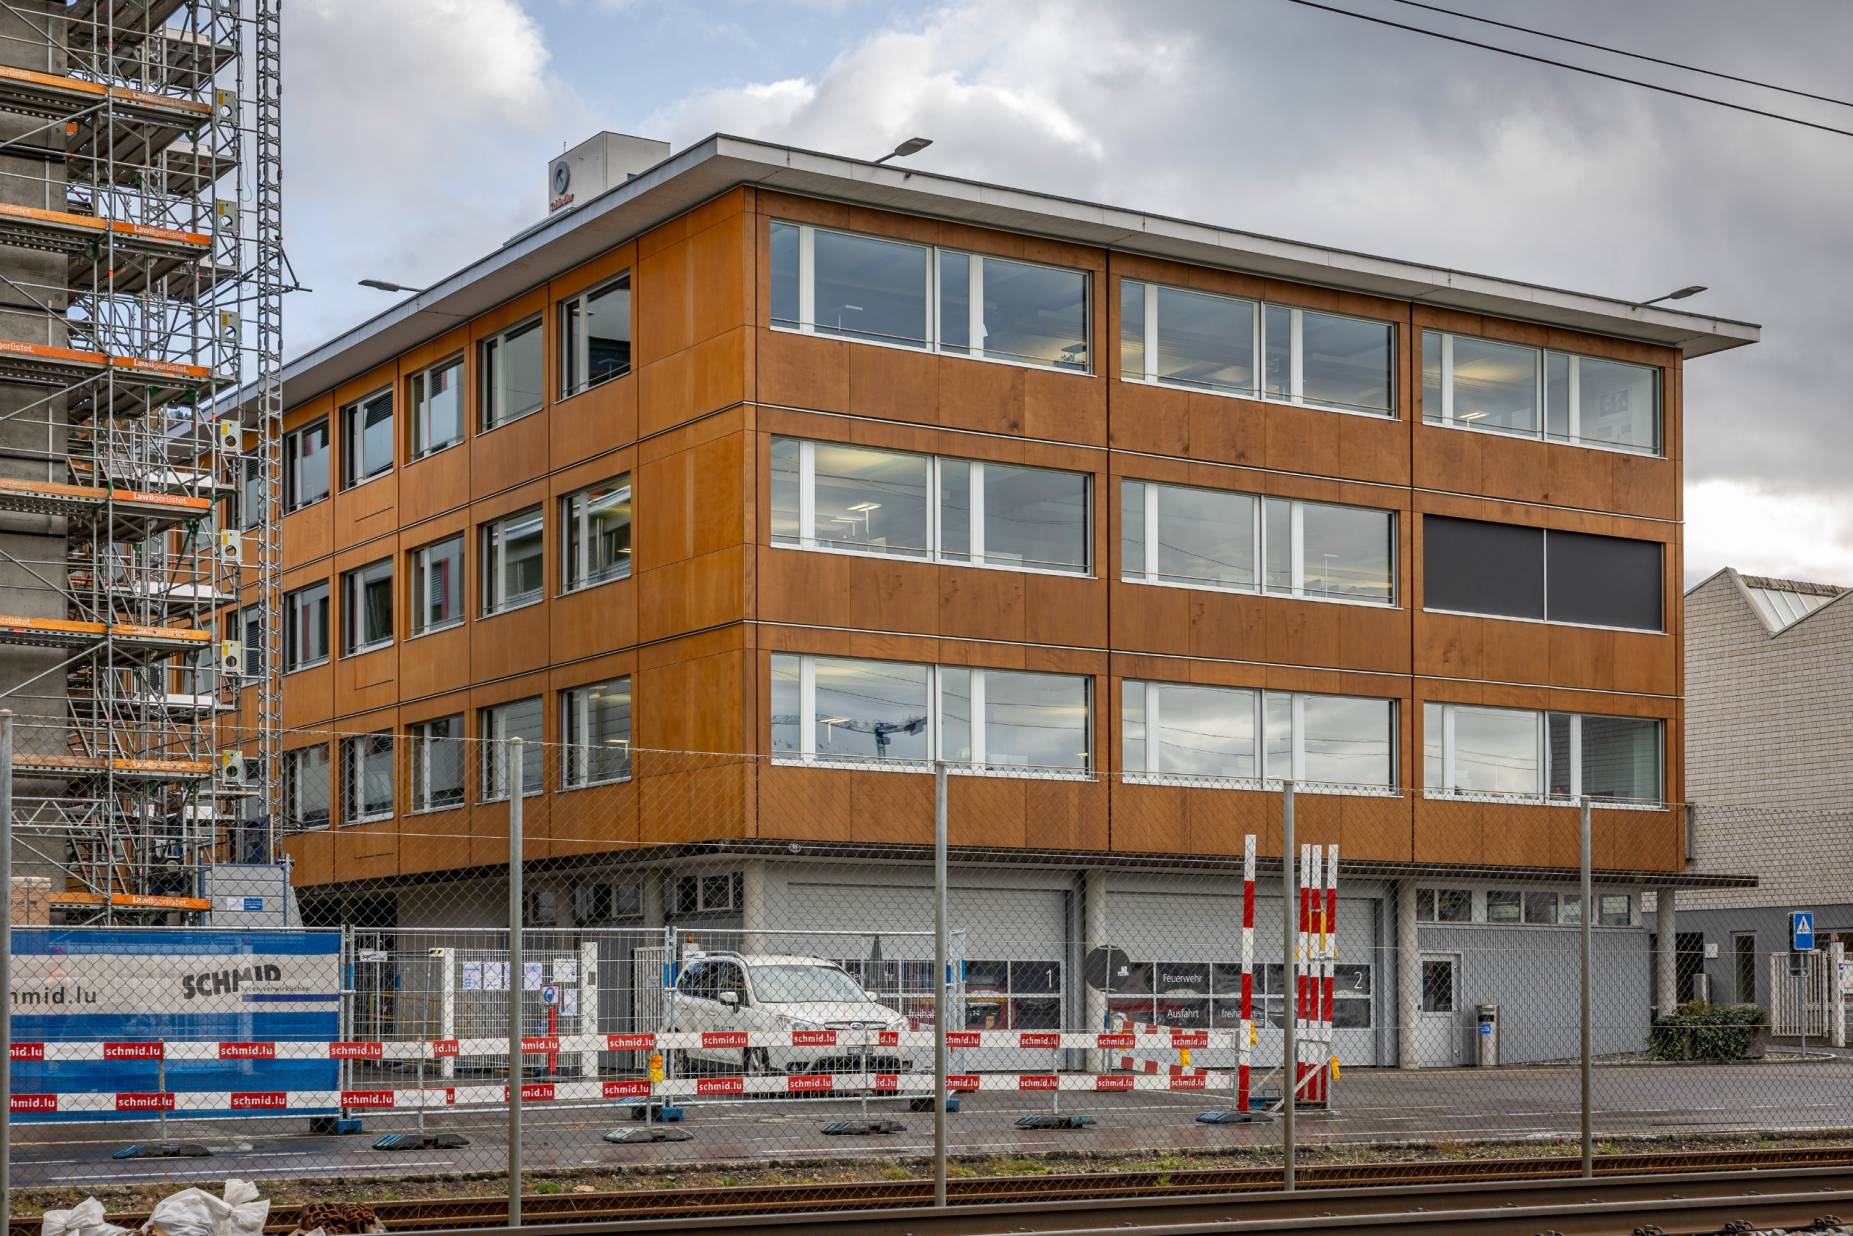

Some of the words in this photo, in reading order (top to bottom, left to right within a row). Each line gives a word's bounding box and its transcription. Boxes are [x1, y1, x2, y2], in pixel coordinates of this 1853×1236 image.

[183, 964, 281, 1000] SCHMID
[1046, 969, 1052, 988] 1
[1162, 973, 1202, 983] Feuerwehr
[1354, 971, 1363, 989] 2
[1167, 1009, 1199, 1018] Ausfahrt
[609, 1037, 655, 1047] schmid.lu
[703, 1036, 746, 1045] schmid.lu
[794, 1034, 836, 1043] schmid.lu
[1021, 1036, 1058, 1045] schmid.lu
[1099, 1036, 1134, 1046] schmid.lu
[1173, 1036, 1208, 1046] schmid.lu
[220, 1045, 273, 1055] schmid.lu
[331, 1045, 381, 1055] schmid.lu
[434, 1043, 458, 1053] id.lu
[521, 1040, 558, 1050] hmid.lu
[106, 1046, 160, 1056] schmid.lu
[698, 1081, 742, 1091] schmid.lu
[790, 1078, 832, 1087] schmid.lu
[1020, 1077, 1058, 1087] schmid.lu
[1098, 1077, 1133, 1087] schmid.lu
[1171, 1077, 1206, 1087] schmid.lu
[605, 1084, 650, 1094] schmid.lu
[10, 1098, 55, 1107] hmid.lu
[118, 1096, 172, 1106] schmid.lu
[233, 1095, 285, 1105] schmid.lu
[343, 1094, 393, 1104] schmid.lu
